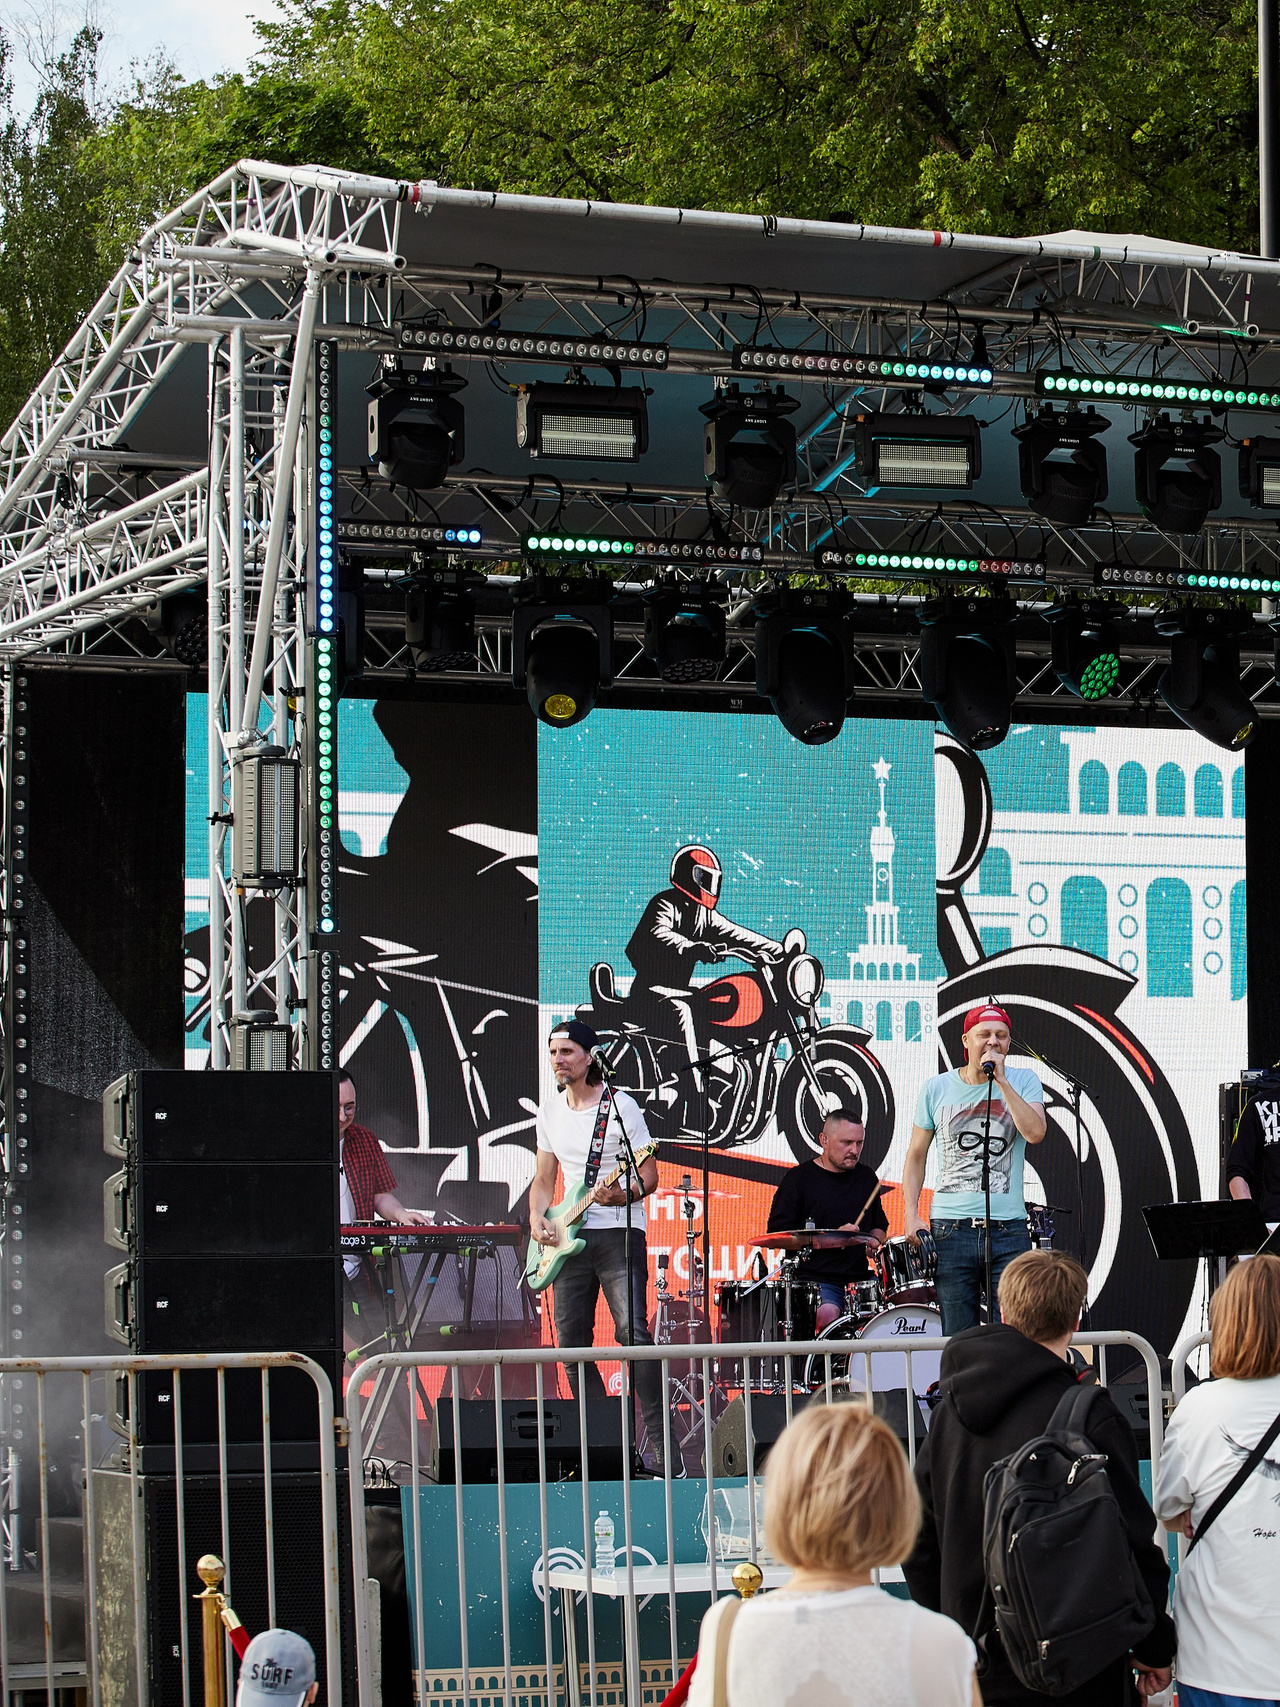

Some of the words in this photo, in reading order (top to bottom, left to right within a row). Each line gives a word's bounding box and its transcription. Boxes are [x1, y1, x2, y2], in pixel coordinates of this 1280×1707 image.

[155, 1112, 167, 1120] RCF
[649, 1194, 703, 1221] НЬ
[340, 1236, 360, 1246] tage
[360, 1236, 366, 1245] 3
[891, 1316, 927, 1335] Pearl
[158, 1394, 170, 1402] RCF
[1253, 1528, 1277, 1540] Hope
[251, 1663, 294, 1685] SURF
